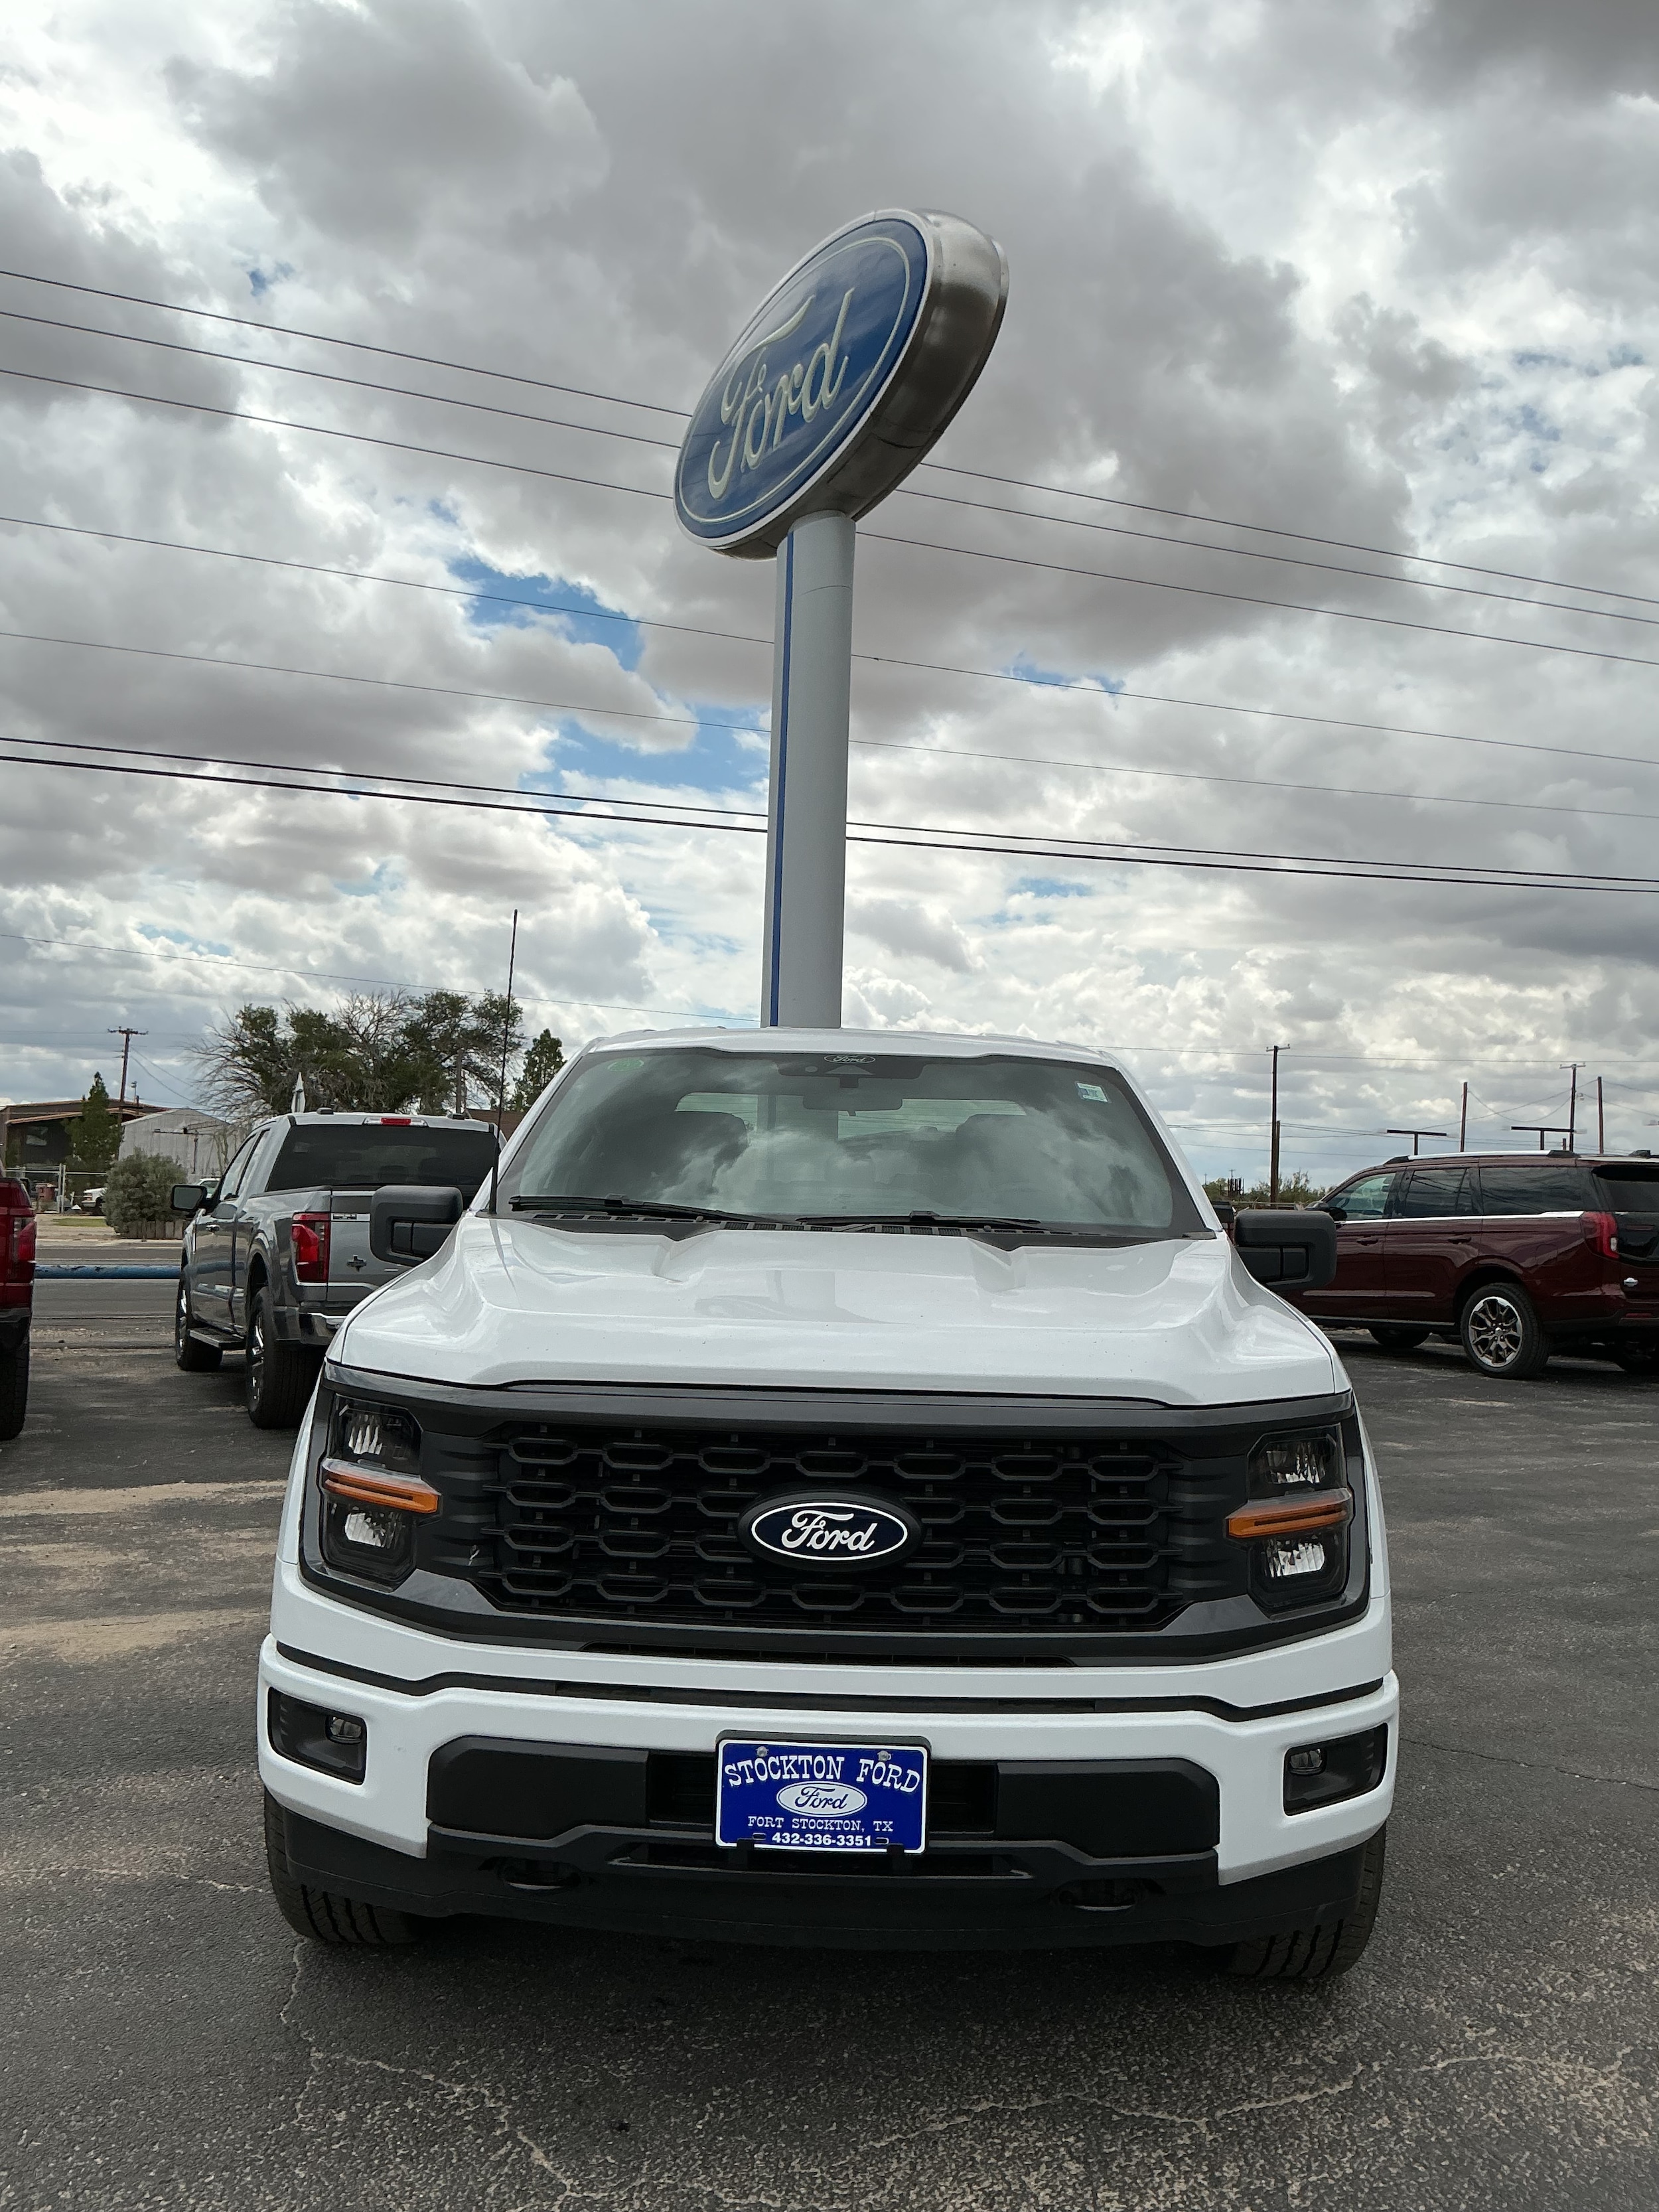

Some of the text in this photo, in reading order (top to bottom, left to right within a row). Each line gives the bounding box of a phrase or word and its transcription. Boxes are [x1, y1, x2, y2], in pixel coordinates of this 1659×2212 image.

[708, 287, 855, 500] Ford
[781, 1509, 878, 1551] Ford
[724, 1755, 920, 1793] STOCKTON FORD
[794, 1786, 849, 1809] Ford
[747, 1816, 894, 1832] FORT STOCKTON, TX
[772, 1832, 871, 1846] 432-336-3351
